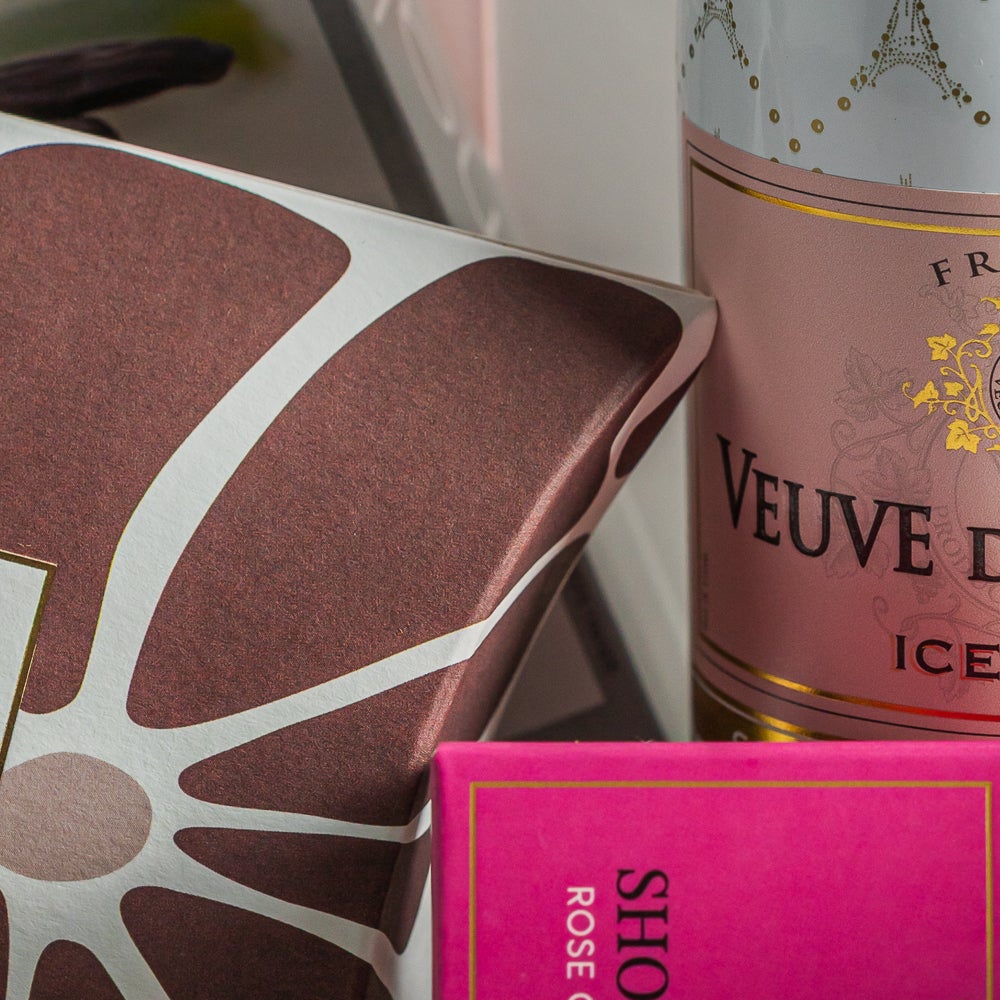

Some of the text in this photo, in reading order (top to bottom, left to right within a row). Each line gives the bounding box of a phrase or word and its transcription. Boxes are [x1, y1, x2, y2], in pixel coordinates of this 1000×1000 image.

[716, 433, 934, 576] VEUVE
[892, 634, 1000, 682] ICE
[566, 886, 595, 979] ROSE
